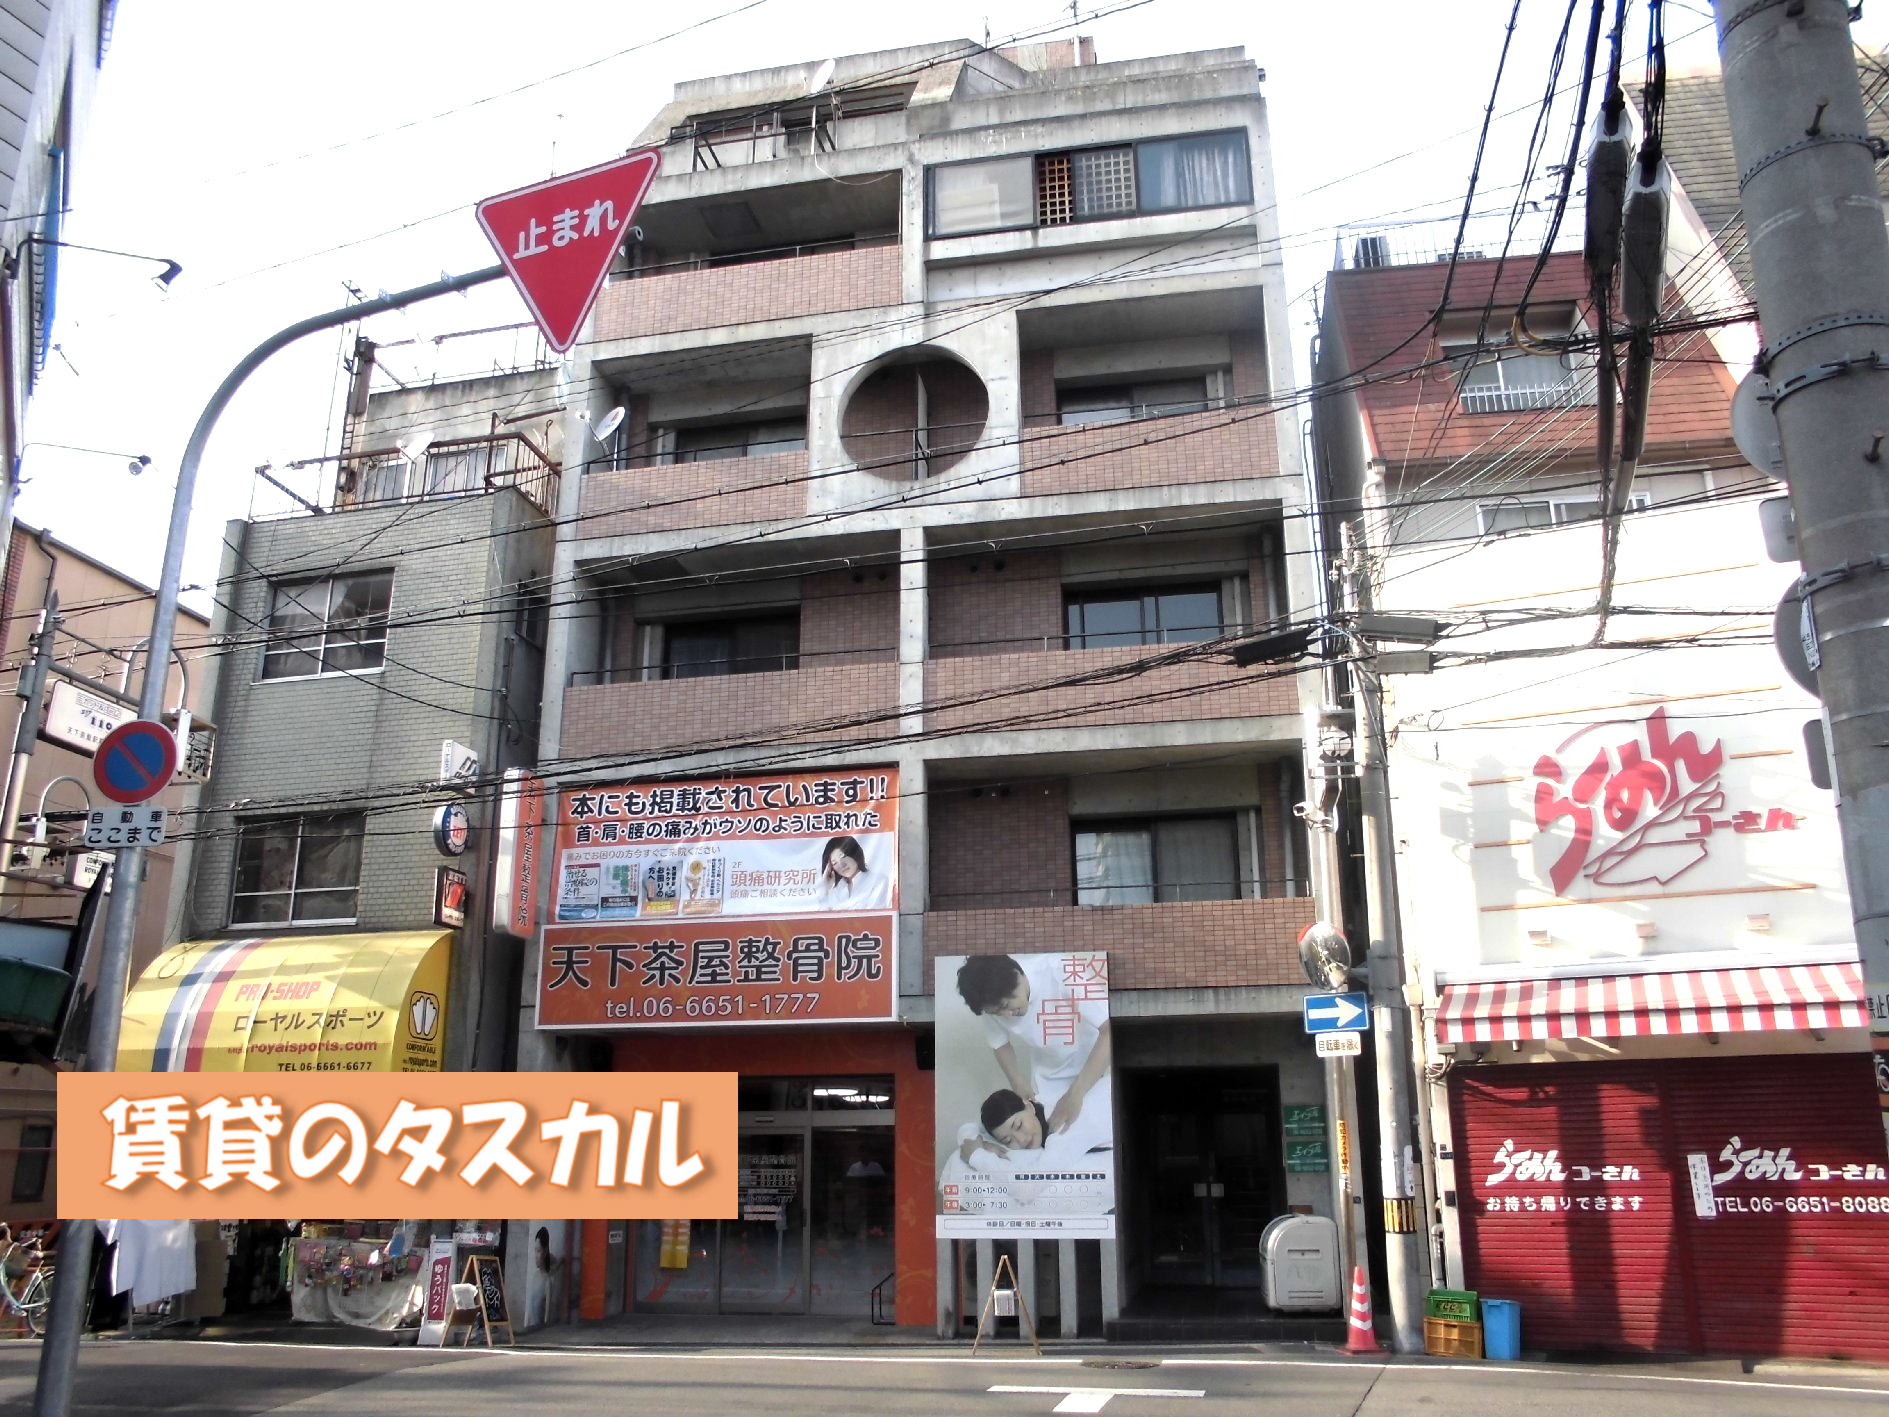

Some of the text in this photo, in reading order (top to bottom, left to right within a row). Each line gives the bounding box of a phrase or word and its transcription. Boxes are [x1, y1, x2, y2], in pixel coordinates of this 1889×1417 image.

[513, 199, 619, 259] 止まれ
[91, 811, 163, 824] 自動車
[575, 810, 880, 843] 首・肩・腰の痛みがウソのように取れた
[1684, 807, 1801, 839] コーさん
[88, 826, 162, 844] ここまで
[731, 861, 743, 869] 2F
[731, 868, 817, 887] 頭痛研究所
[547, 931, 883, 990] 天下茶屋整骨院
[605, 992, 821, 1019] tel.06-6651-1777
[233, 1009, 385, 1033] ローヤルスポーツ
[1318, 1038, 1359, 1052] 自転車を除く
[278, 1063, 298, 1072] TEL
[1572, 1165, 1641, 1181] コーさん
[1808, 1163, 1887, 1181] コーさん
[965, 1201, 983, 1209] 3:00
[990, 1201, 1008, 1209] 7:30
[1486, 1195, 1644, 1212] お持ち帰りできます
[1714, 1196, 1889, 1213] TEL 06-6651-8088
[430, 1263, 445, 1315] ゆうパック
